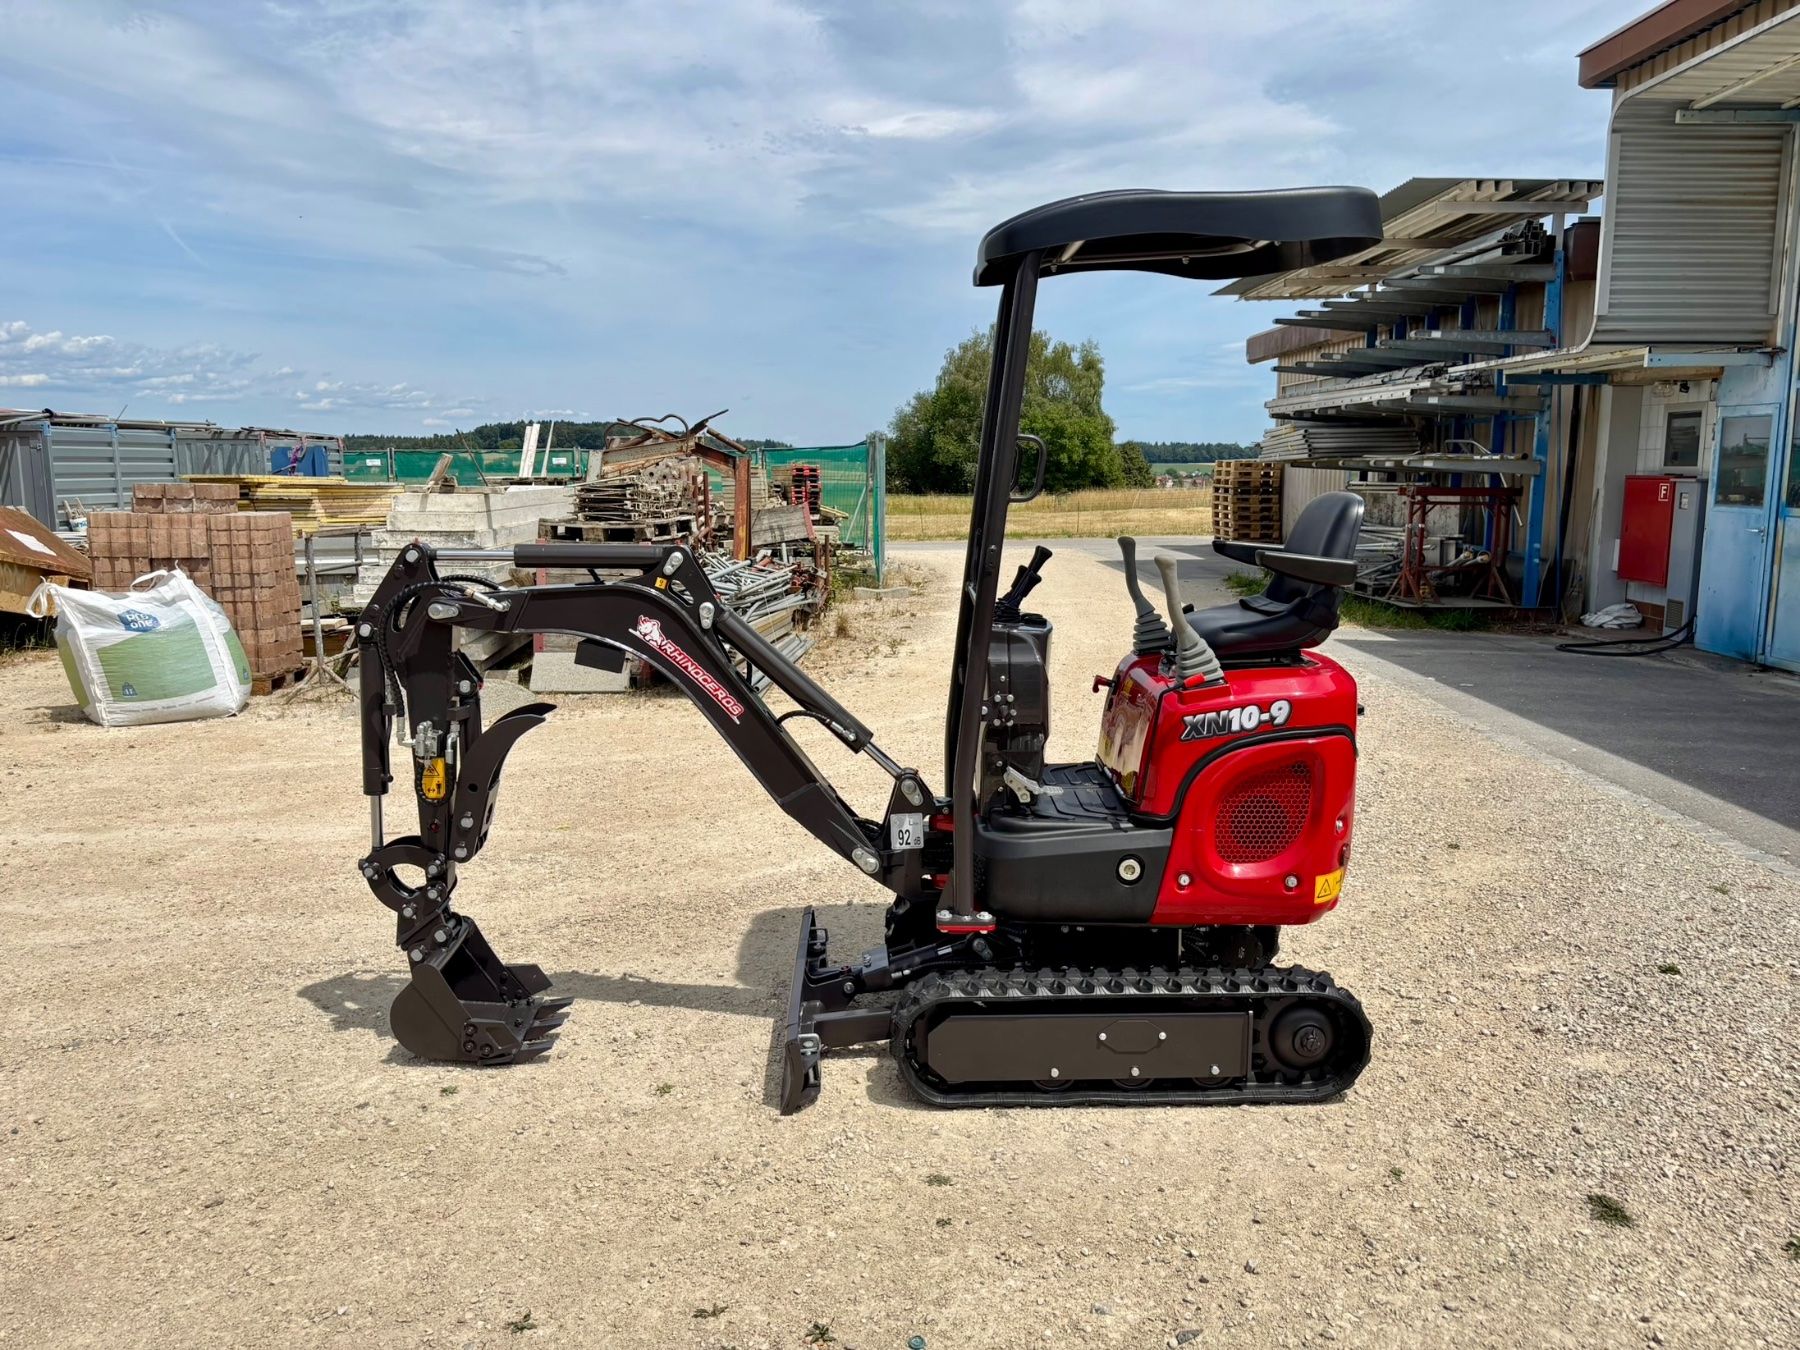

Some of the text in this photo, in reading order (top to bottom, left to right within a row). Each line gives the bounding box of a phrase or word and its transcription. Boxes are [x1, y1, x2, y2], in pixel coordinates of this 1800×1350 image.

[1660, 485, 1667, 499] F
[660, 640, 744, 717] RHINOCEROS
[1181, 700, 1291, 740] XN10-9
[898, 829, 911, 846] 92
